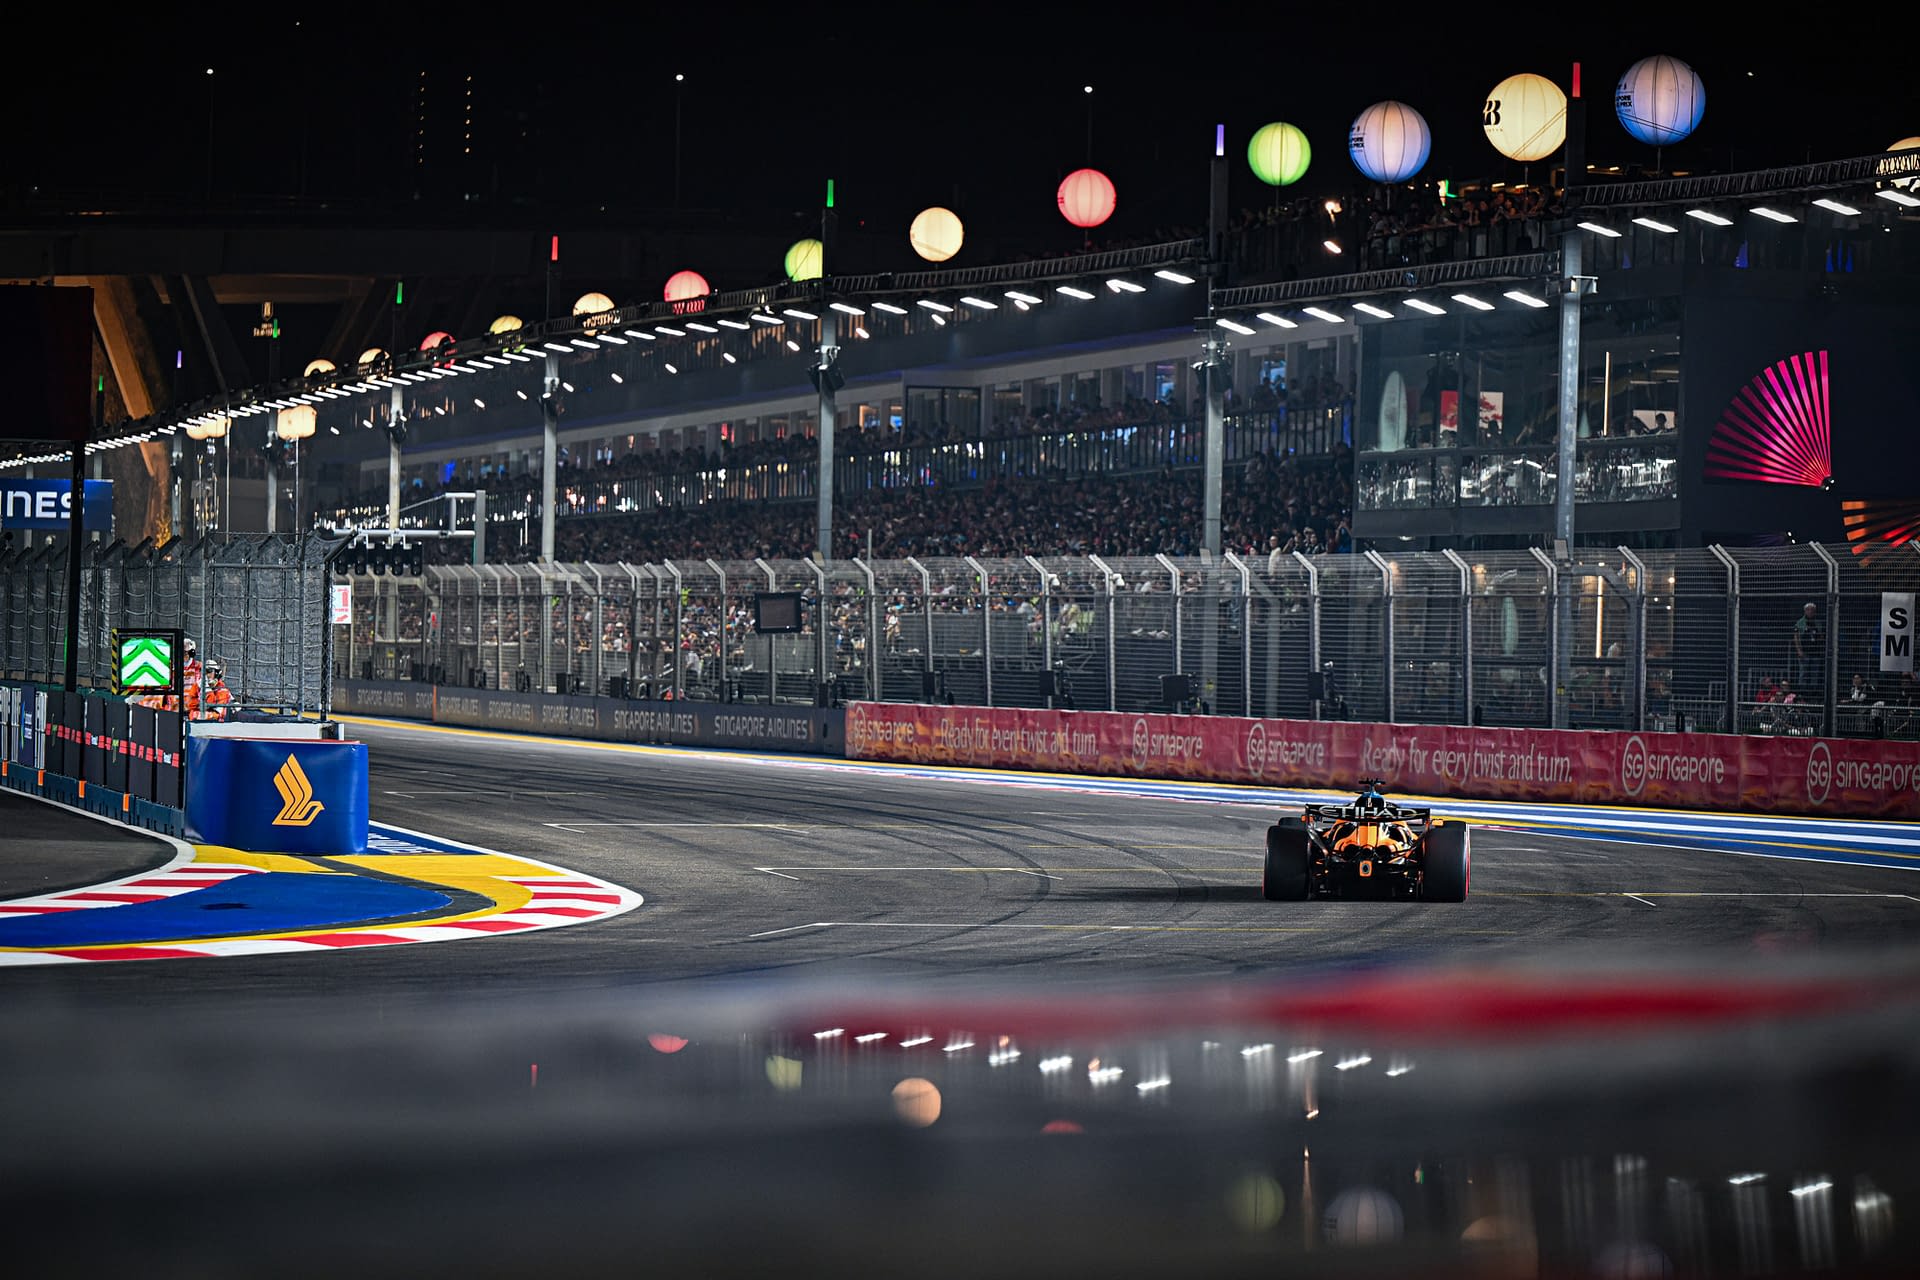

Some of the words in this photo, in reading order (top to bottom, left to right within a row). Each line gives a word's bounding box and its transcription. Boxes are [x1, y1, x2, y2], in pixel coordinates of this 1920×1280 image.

[614, 709, 655, 731] SINGAPORE
[656, 712, 693, 733] AIRLINES
[714, 715, 764, 737] SINGAPORE
[767, 717, 808, 739] AIRLINES
[1021, 722, 1048, 753] twist
[1362, 736, 1406, 781] Ready
[1409, 736, 1428, 774] for
[1432, 748, 1471, 785] every
[1473, 743, 1506, 779] twist
[1508, 743, 1534, 781] and
[1537, 751, 1572, 783] turn.
[1319, 805, 1418, 819] ETIHAD
